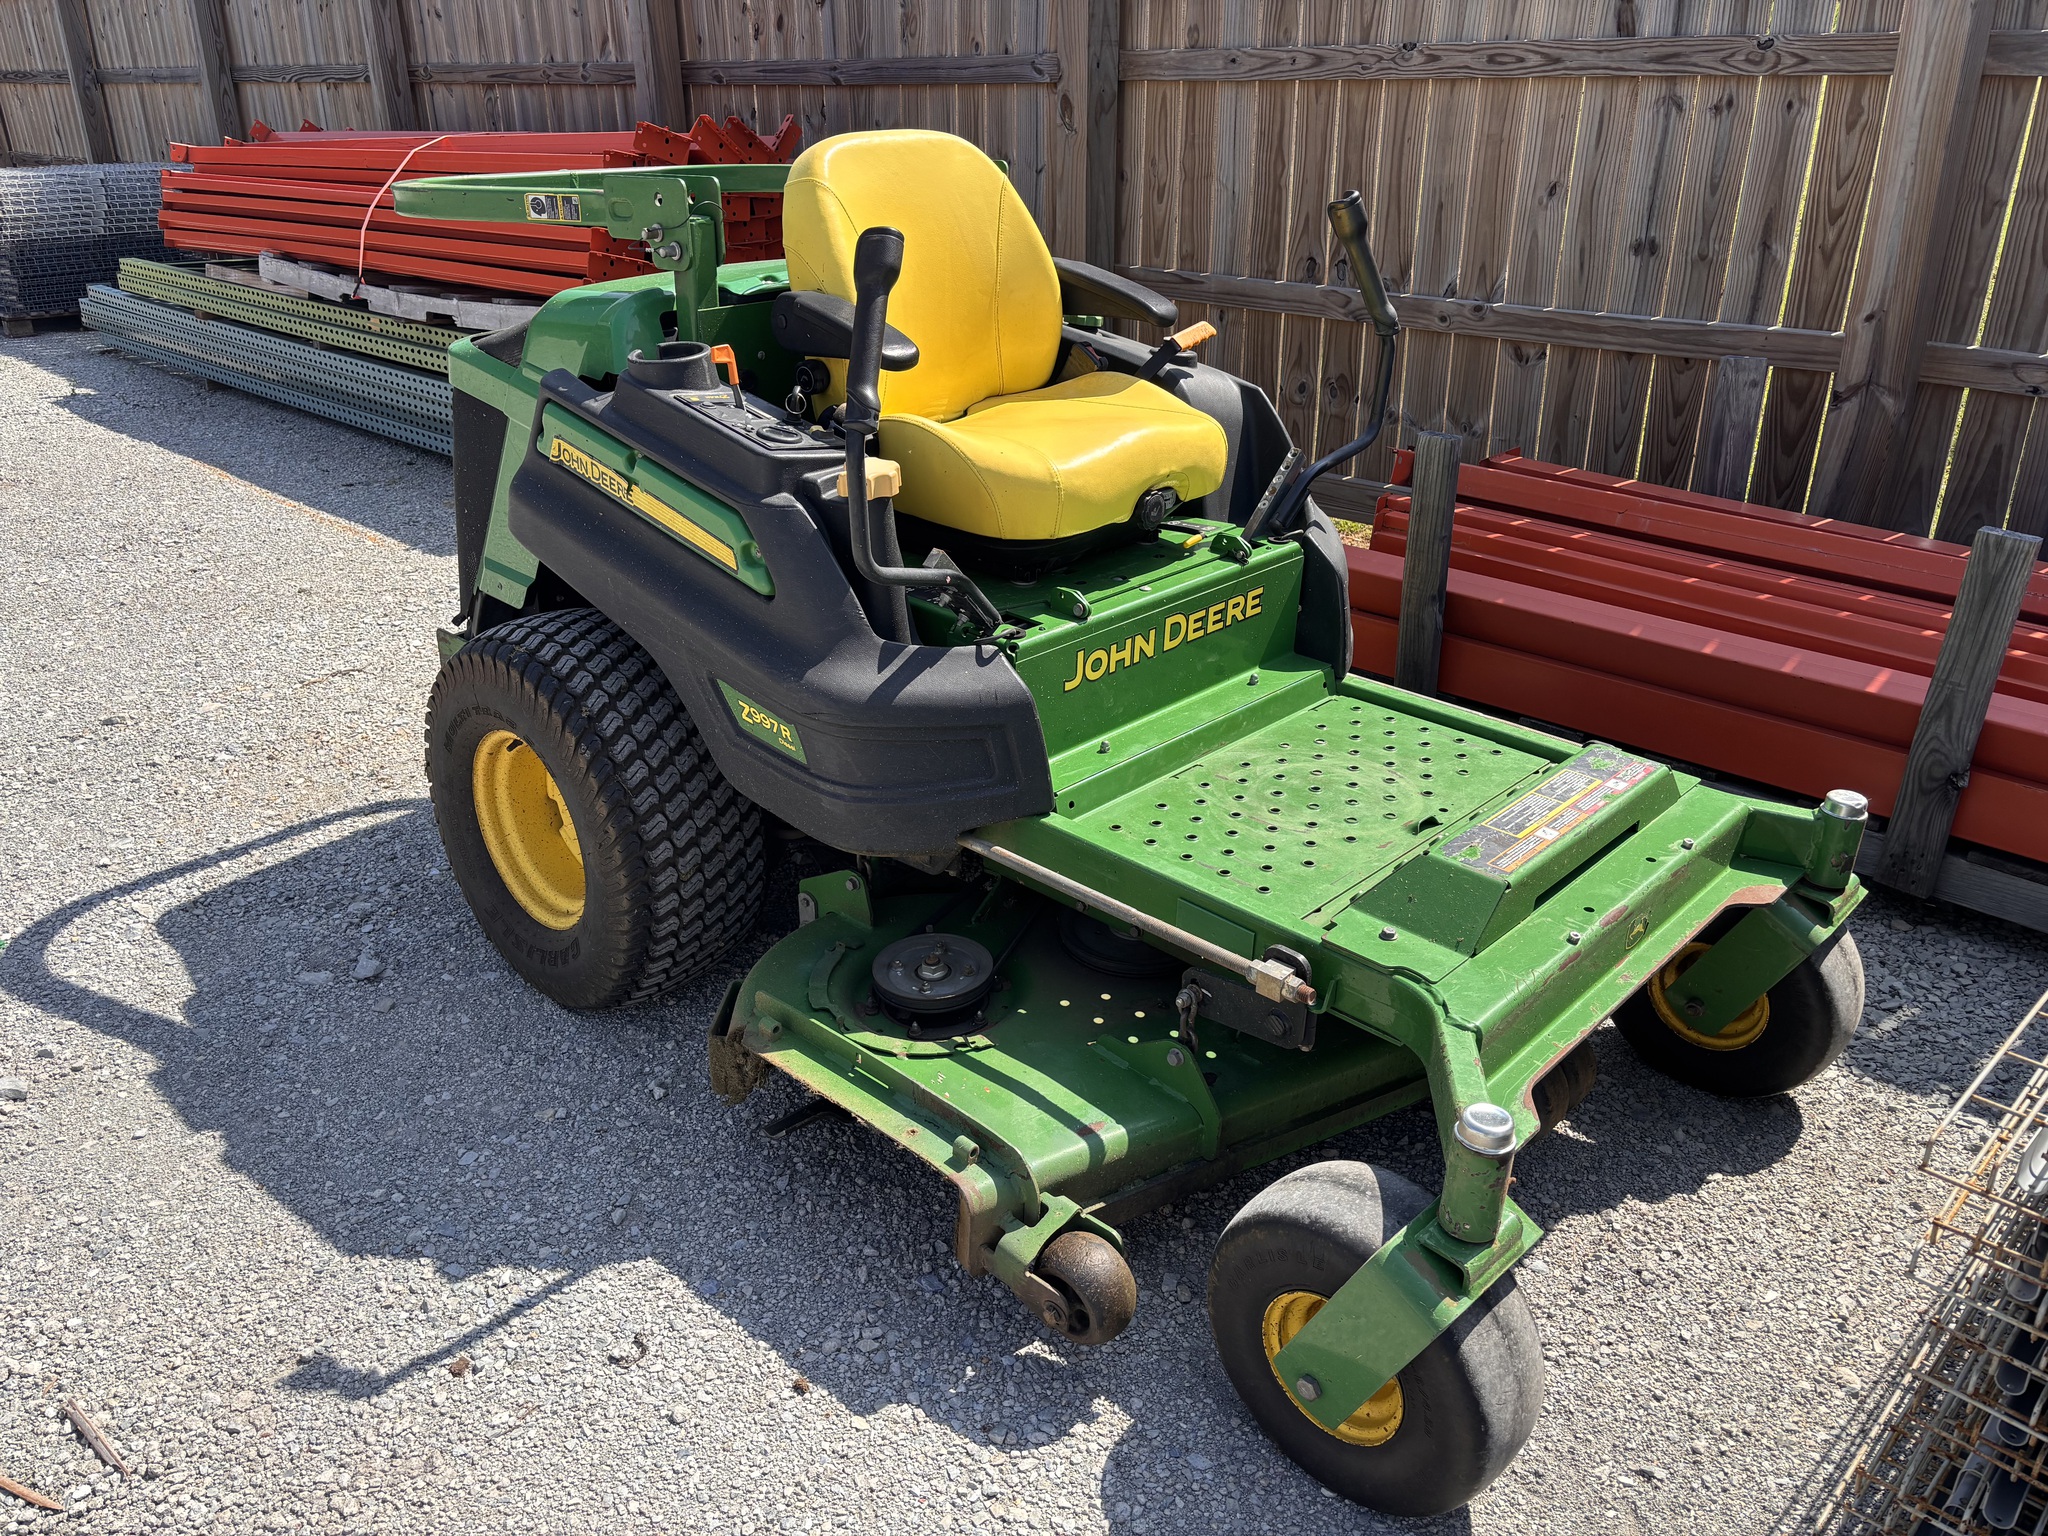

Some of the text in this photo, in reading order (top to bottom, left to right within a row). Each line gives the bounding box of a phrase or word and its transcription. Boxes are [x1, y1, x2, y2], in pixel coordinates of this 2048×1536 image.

[551, 442, 634, 504] JOHN DEERE
[1063, 584, 1265, 693] JOHN DEERE
[483, 901, 581, 969] CARLISLE
[1226, 1247, 1326, 1291] CARLISLE
